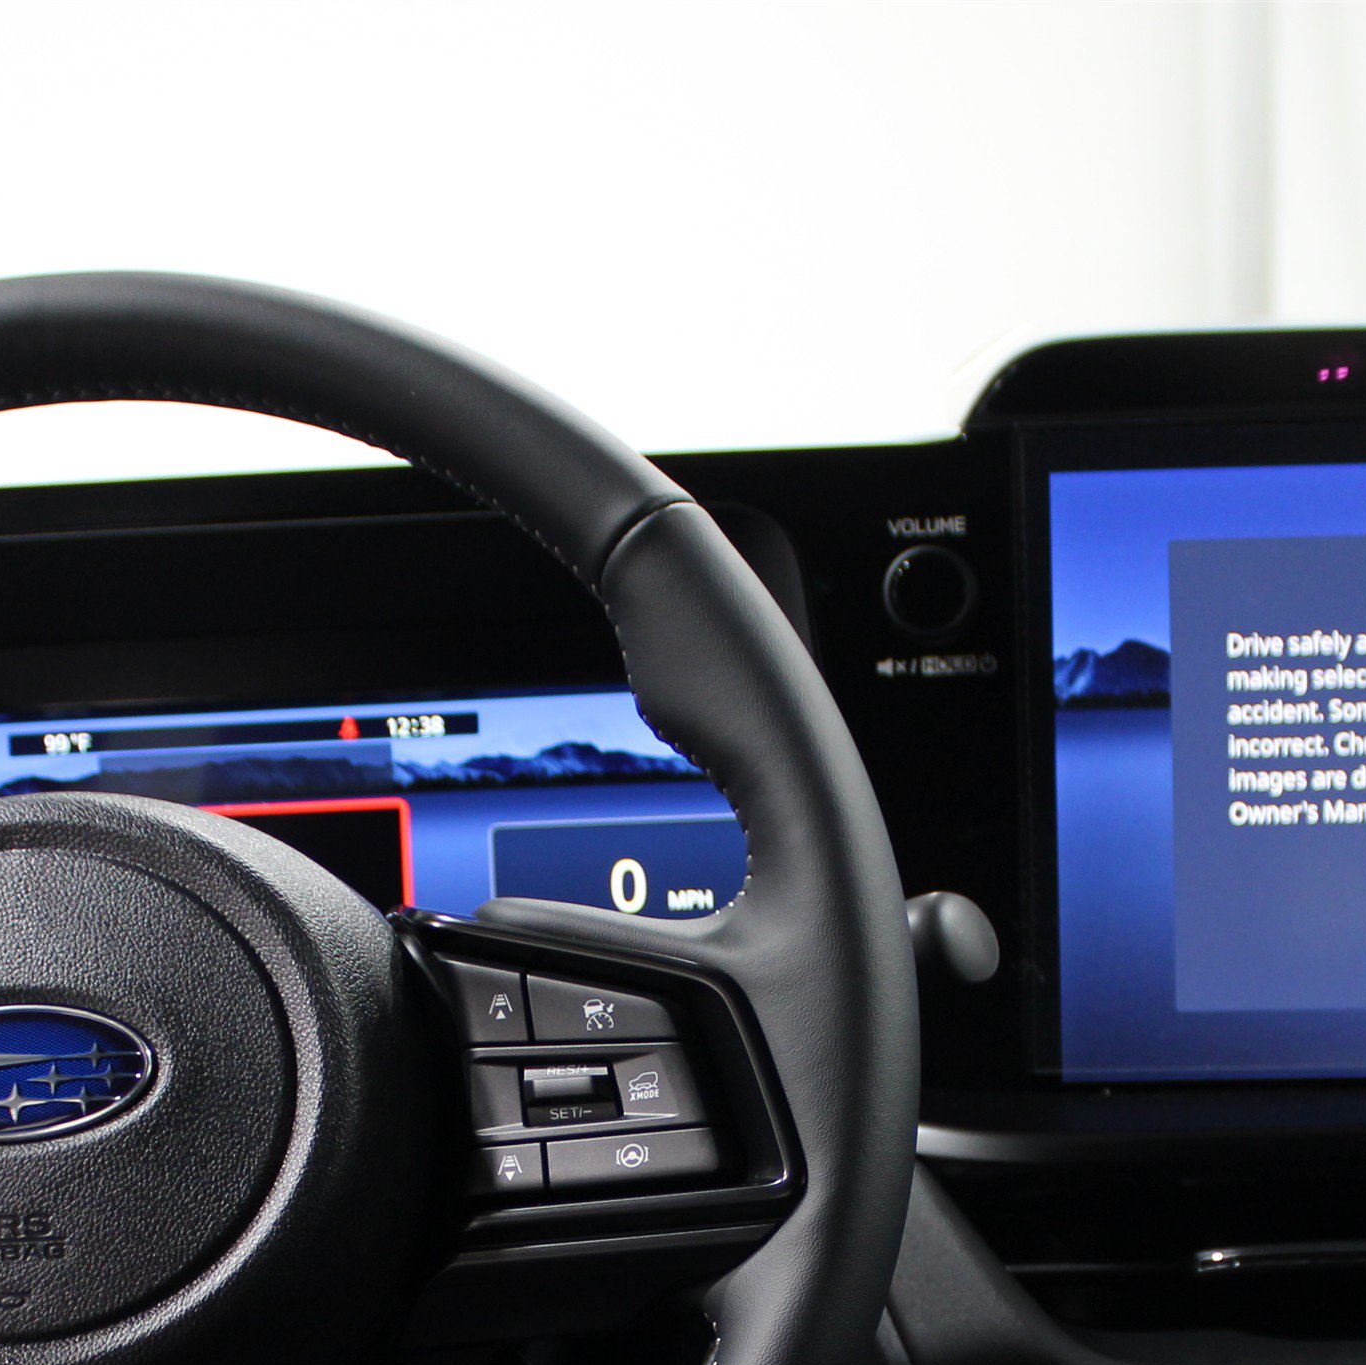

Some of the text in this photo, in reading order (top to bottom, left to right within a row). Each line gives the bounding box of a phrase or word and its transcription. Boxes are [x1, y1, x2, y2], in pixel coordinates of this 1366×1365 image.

[887, 515, 967, 537] VOLUME
[1227, 633, 1283, 656] Drive
[1289, 630, 1351, 659] safely
[1228, 666, 1307, 694] making
[1228, 699, 1324, 724] accident.
[1229, 734, 1329, 757] incorrect.
[1229, 768, 1307, 796] images
[1312, 770, 1347, 789] are
[1230, 801, 1319, 824] Owner's
[610, 858, 714, 914] 0 MPH
